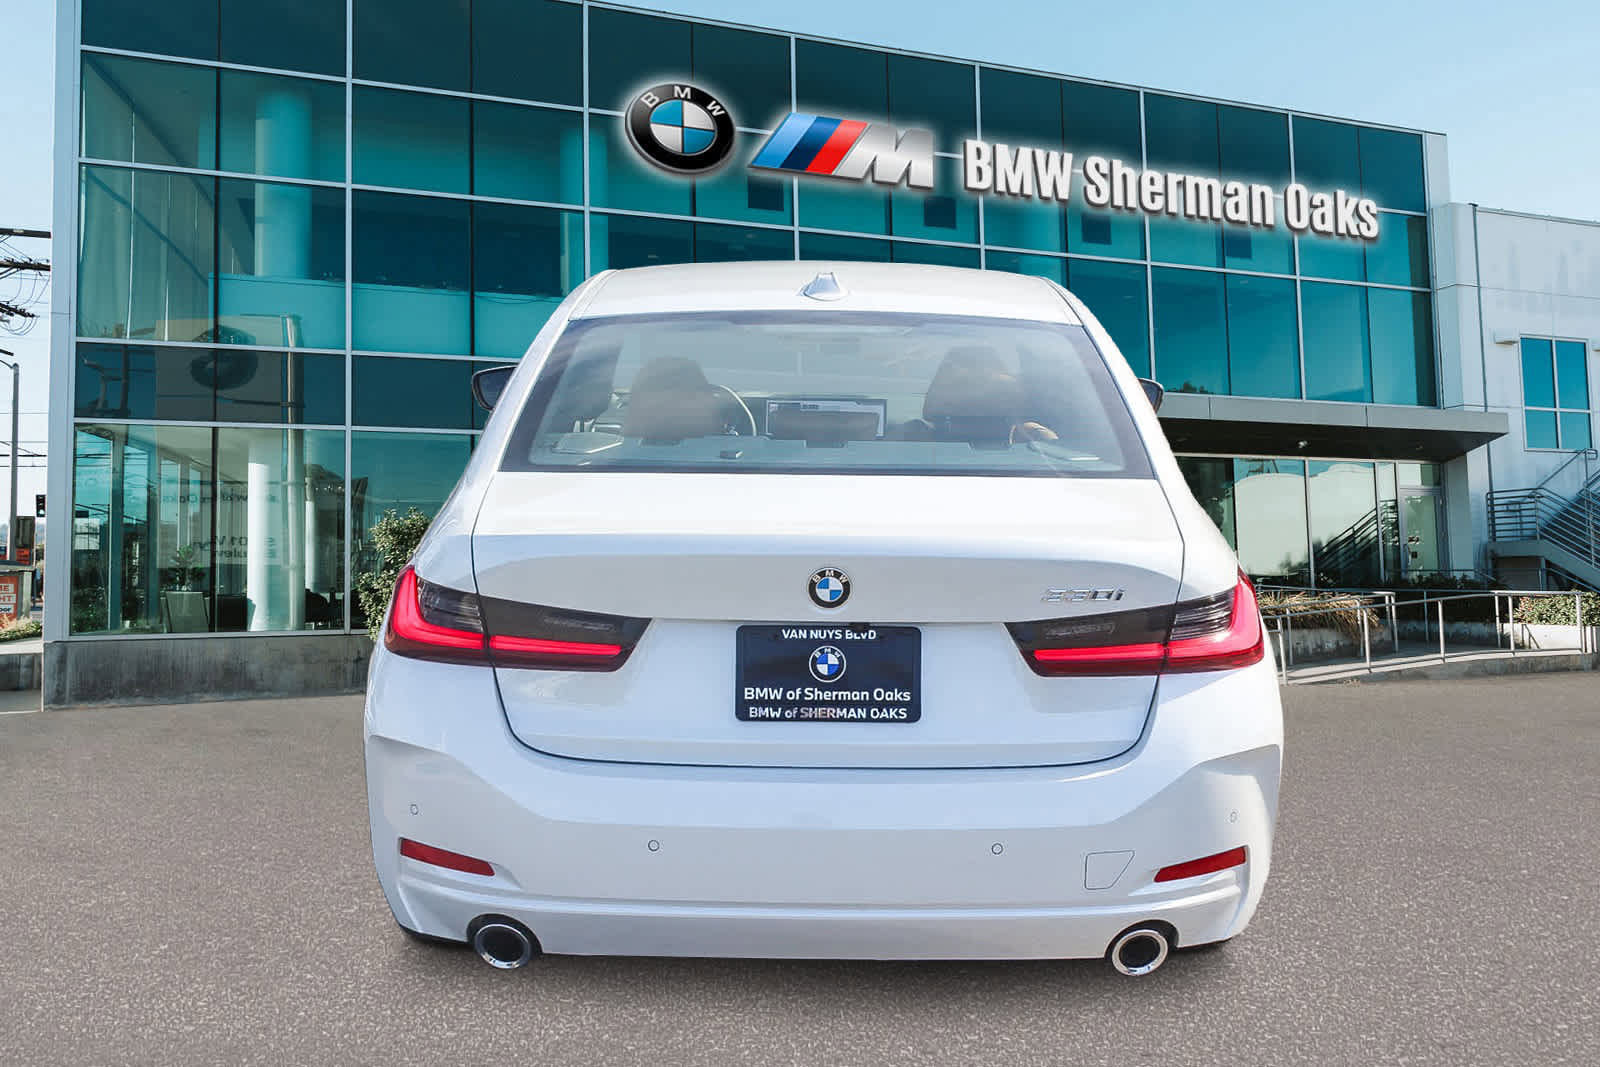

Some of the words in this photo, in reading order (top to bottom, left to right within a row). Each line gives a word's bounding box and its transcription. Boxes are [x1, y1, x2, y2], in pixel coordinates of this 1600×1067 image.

[641, 85, 725, 118] BMW
[963, 139, 1073, 201] BMW
[1083, 155, 1274, 230] Sherman
[1284, 183, 1379, 243] Oaks
[812, 570, 848, 583] BMW
[782, 629, 807, 640] VAN
[809, 629, 843, 640] NUYS
[814, 648, 841, 659] BMW
[744, 687, 783, 700] BMW
[786, 687, 803, 700] of
[804, 687, 870, 701] Sherman
[873, 688, 911, 701] Oaks
[749, 706, 782, 719] BMW
[784, 706, 799, 719] of
[800, 707, 867, 719] SHERMAN
[870, 708, 908, 719] OAKS
